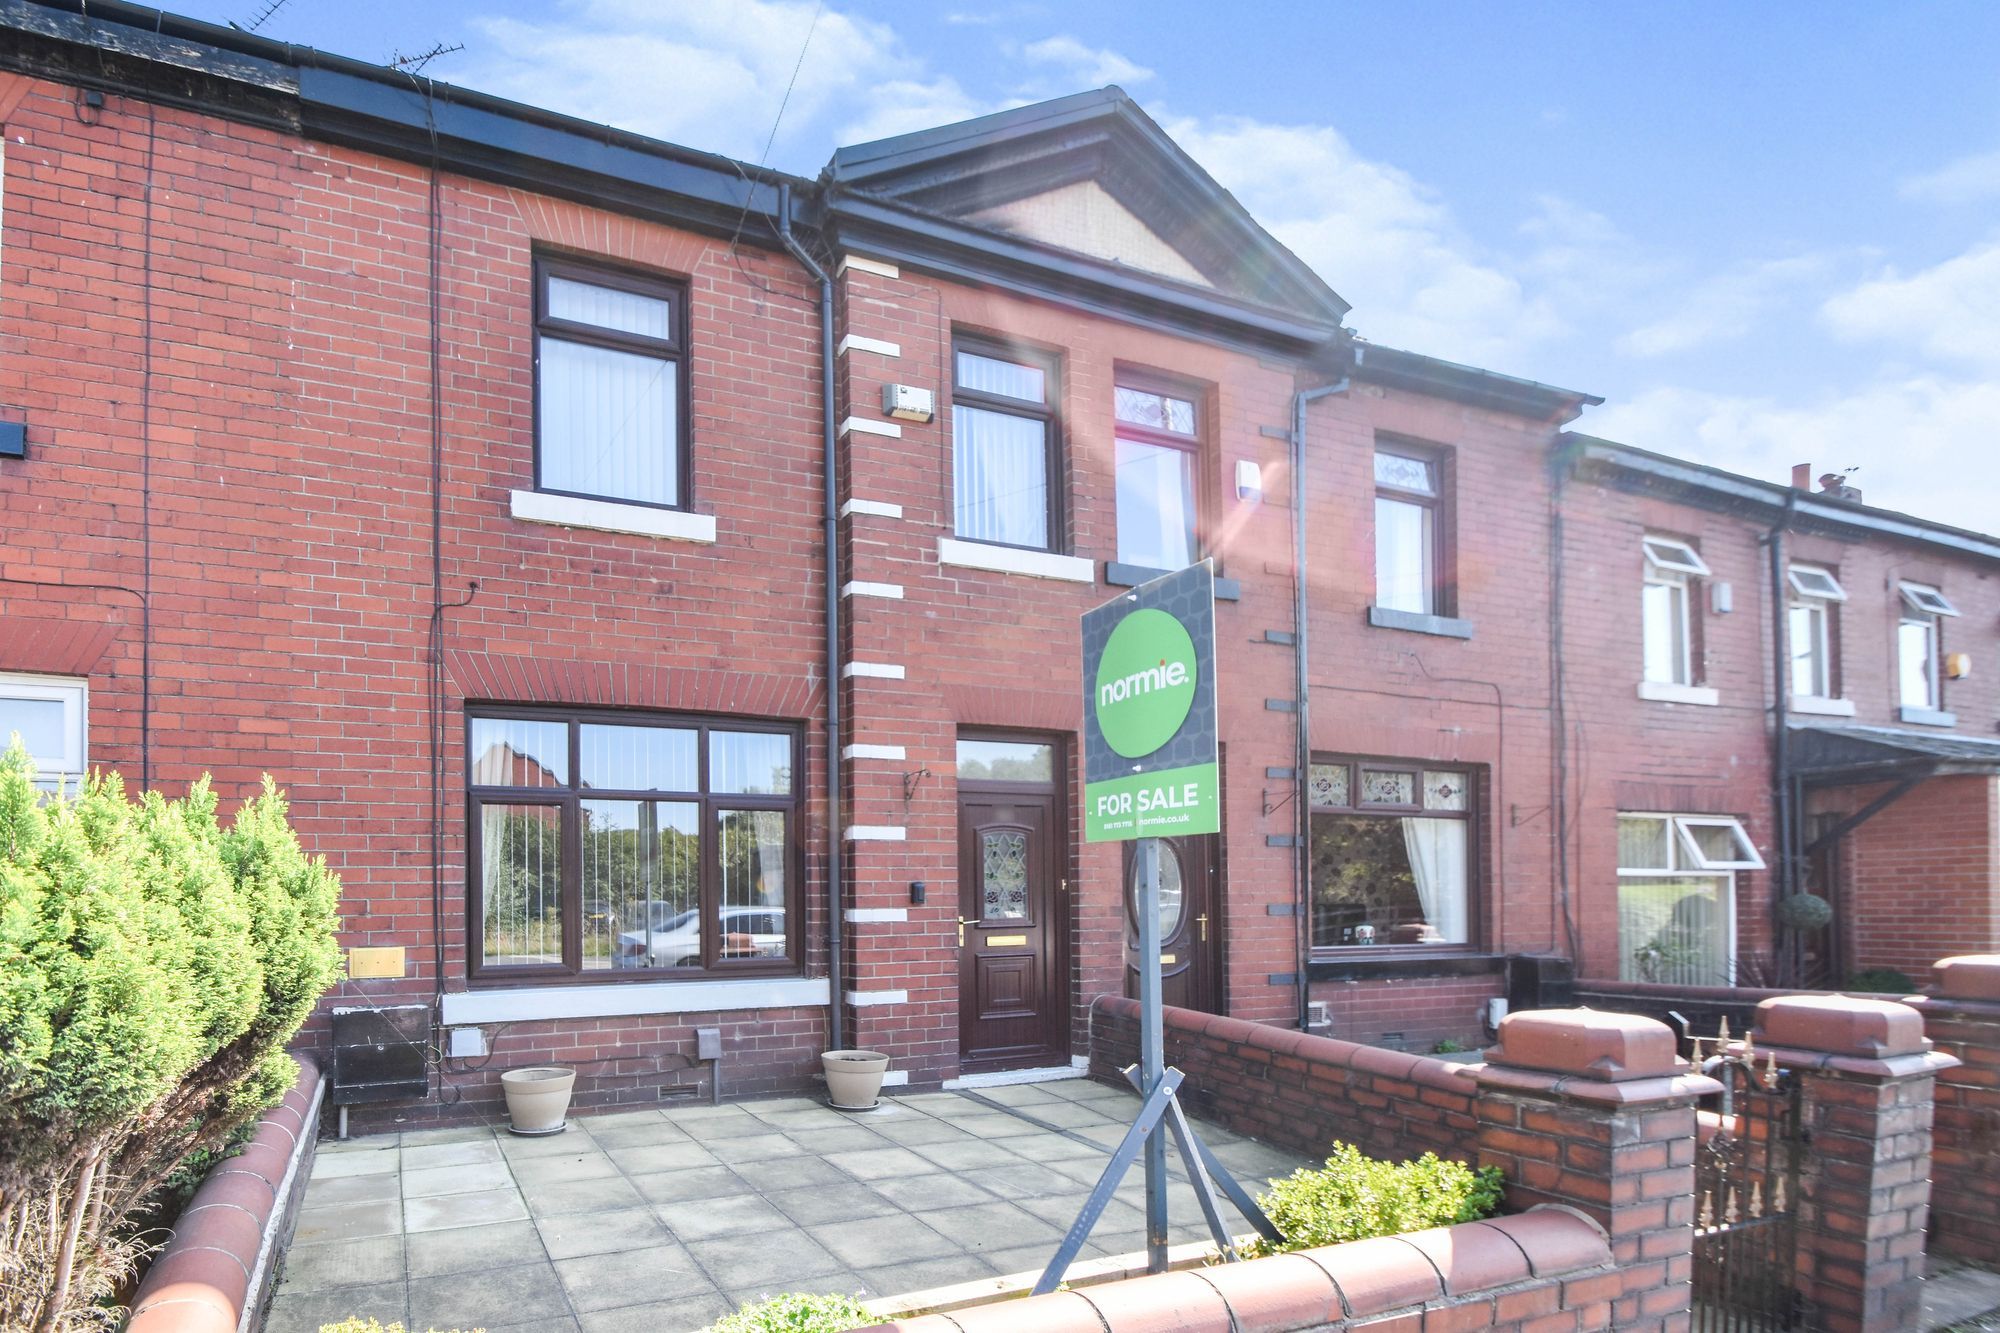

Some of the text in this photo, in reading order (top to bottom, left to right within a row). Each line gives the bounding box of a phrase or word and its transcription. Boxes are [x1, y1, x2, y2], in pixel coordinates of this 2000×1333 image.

[1098, 783, 1199, 817] FOR SALE
[1139, 814, 1189, 826] normie.co.uk
